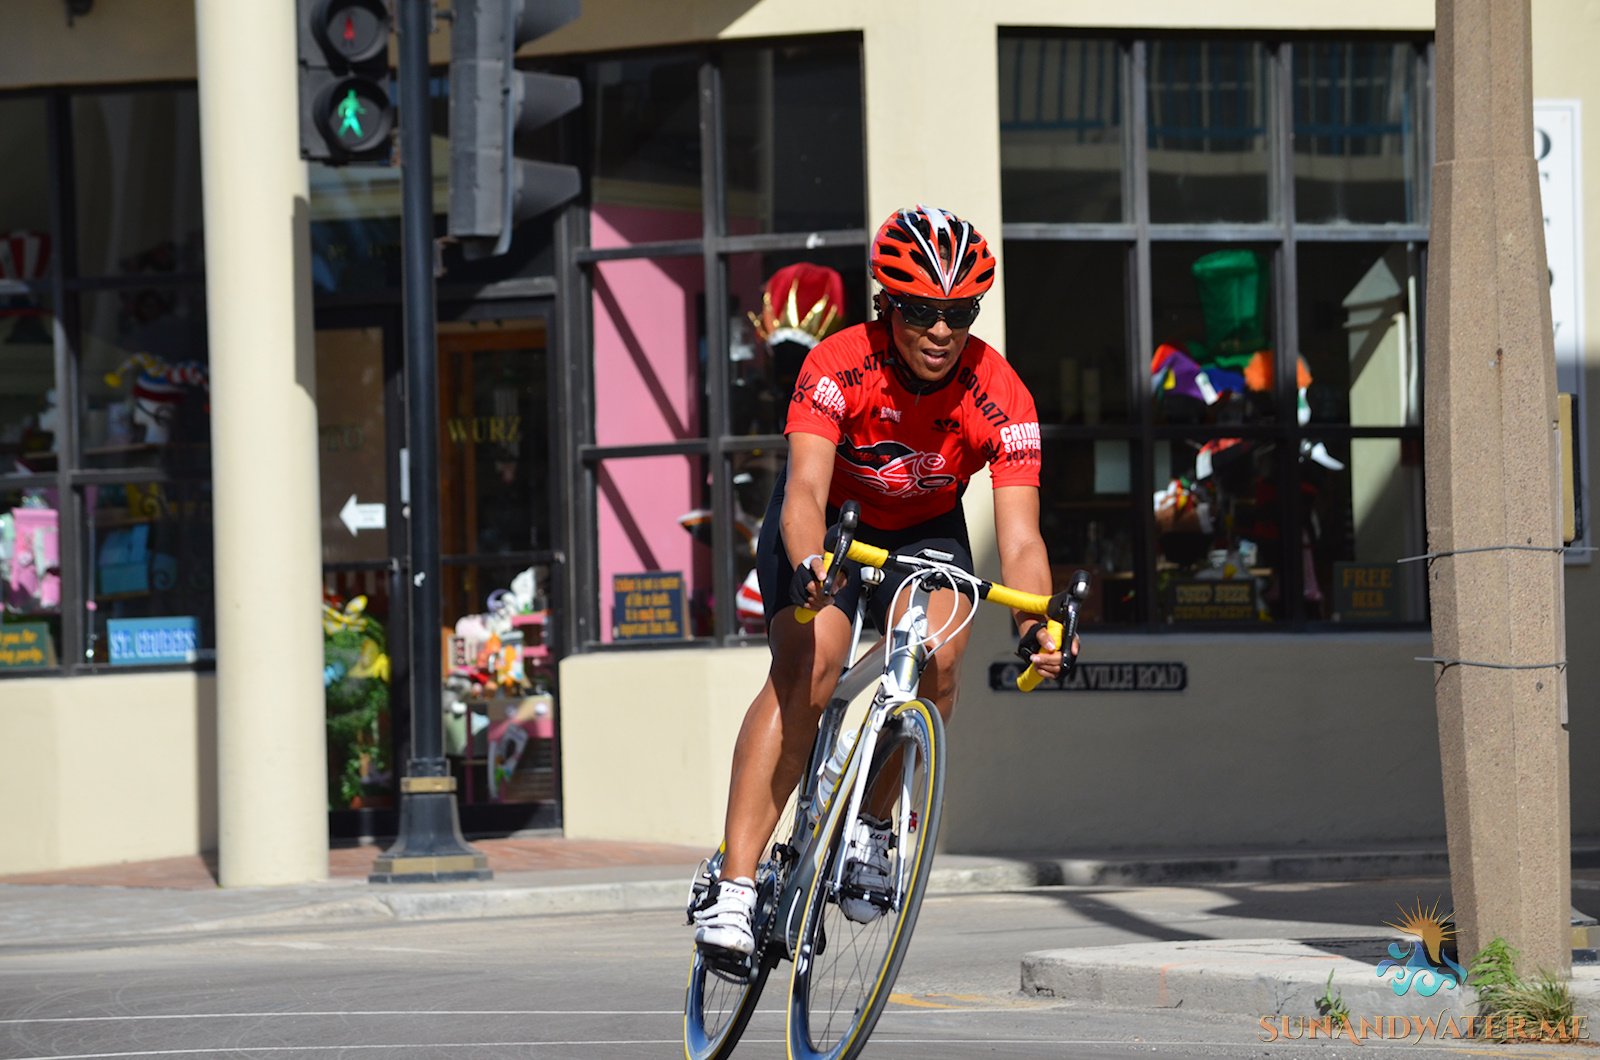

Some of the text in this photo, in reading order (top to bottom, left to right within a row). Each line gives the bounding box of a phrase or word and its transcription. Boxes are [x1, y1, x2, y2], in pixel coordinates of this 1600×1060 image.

[1000, 422, 1040, 444] CRIM
[1086, 664, 1135, 689] VILLE
[1137, 664, 1182, 689] ROAD
